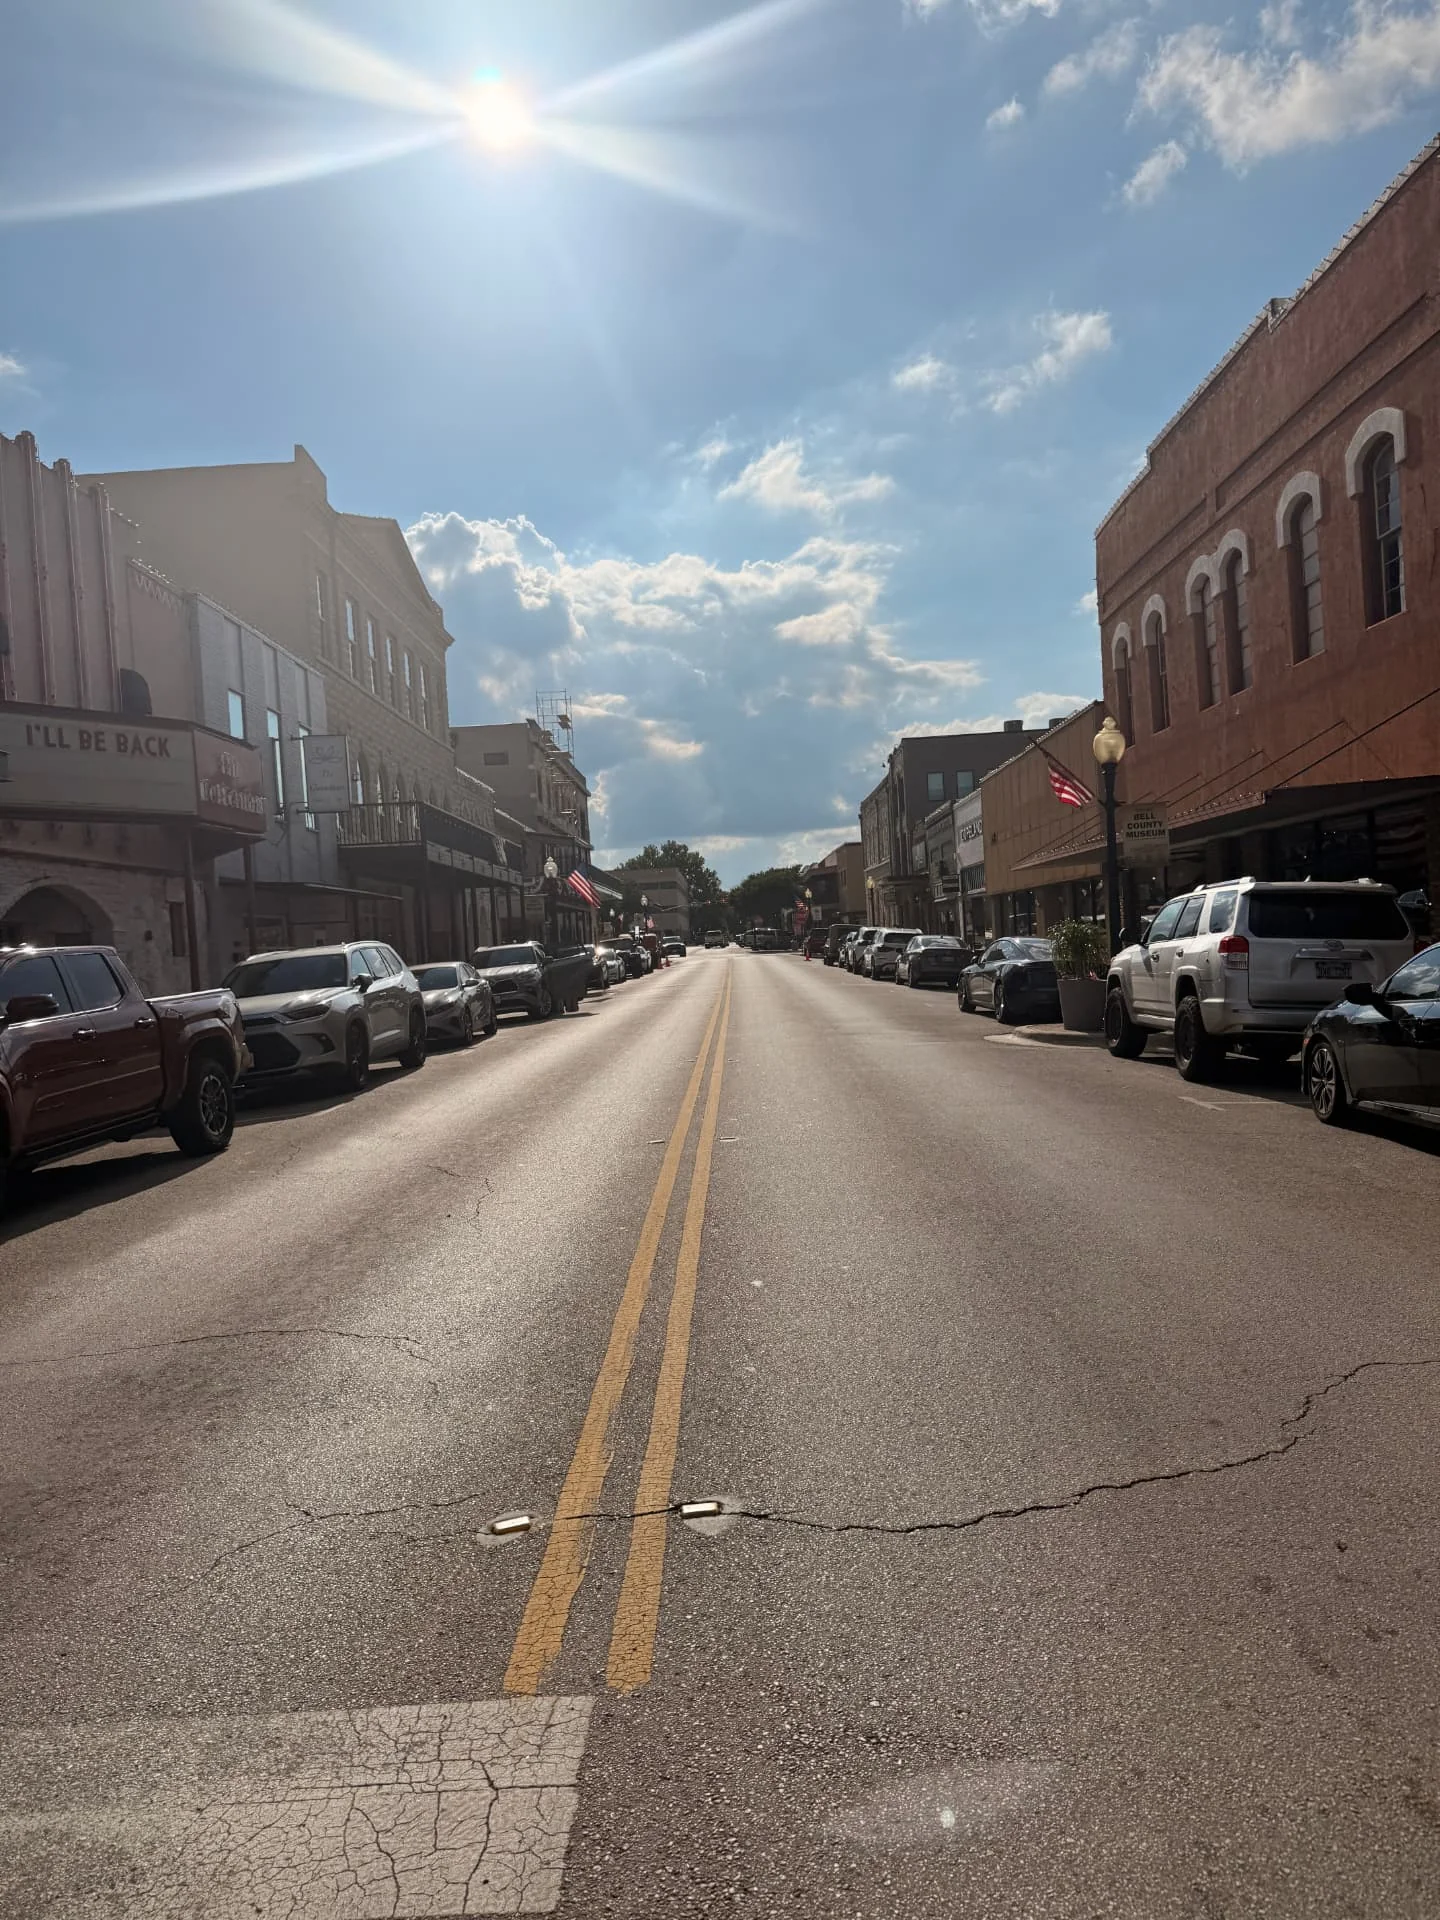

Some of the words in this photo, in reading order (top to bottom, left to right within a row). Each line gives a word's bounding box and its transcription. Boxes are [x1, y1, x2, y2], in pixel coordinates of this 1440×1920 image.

[26, 724, 71, 748] I'LL
[79, 729, 107, 751] BE
[116, 733, 171, 758] BACK
[1134, 812, 1156, 820] BELL
[1127, 821, 1163, 829] COUNTY
[1126, 829, 1165, 838] MUSEUM
